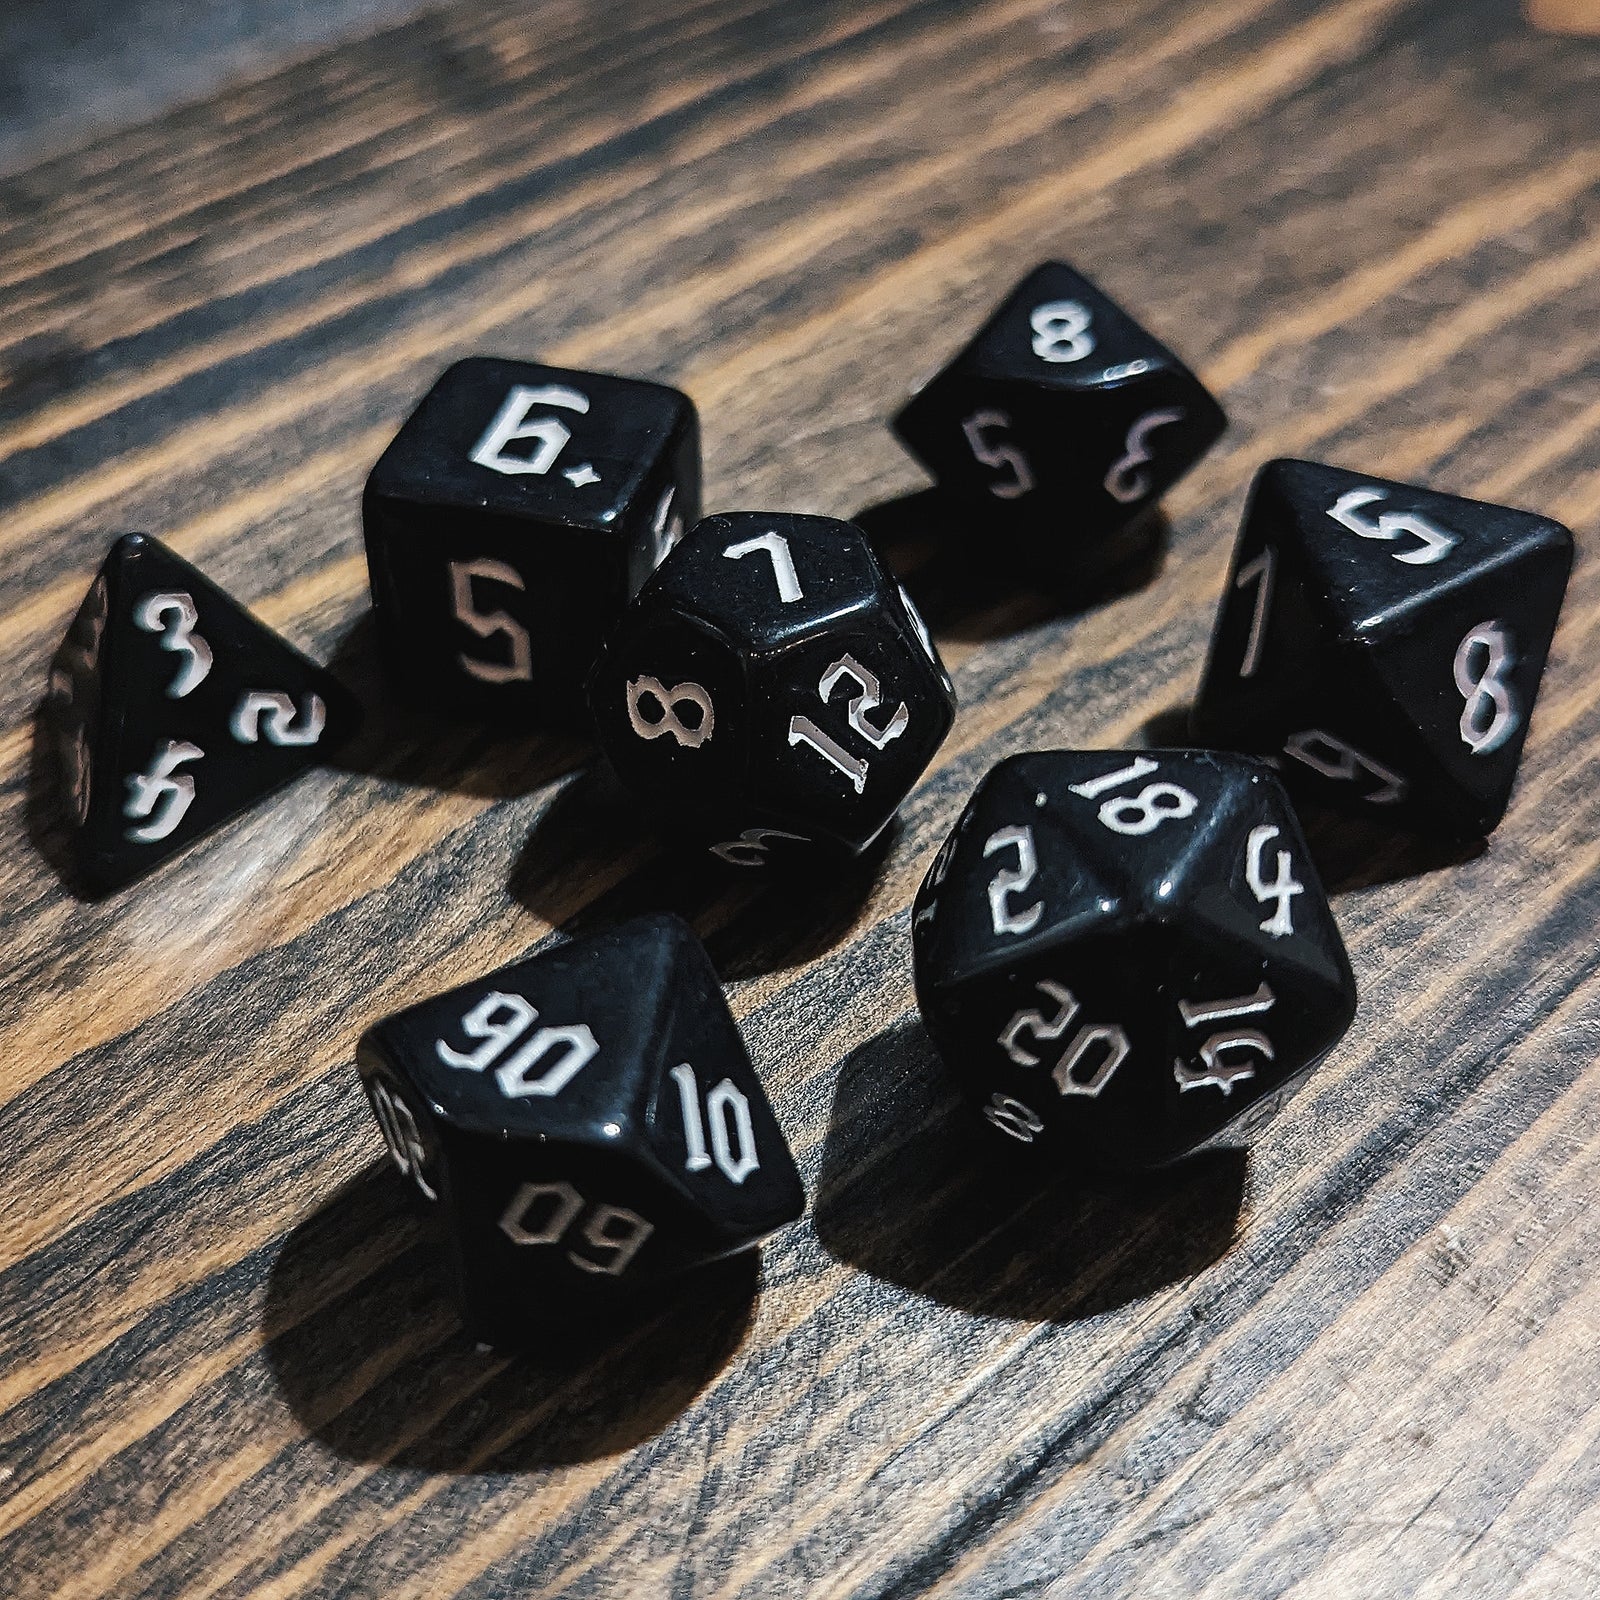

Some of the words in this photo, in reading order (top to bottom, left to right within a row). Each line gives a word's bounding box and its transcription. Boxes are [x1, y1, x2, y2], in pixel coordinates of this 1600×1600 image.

[1030, 300, 1096, 364] 8
[962, 407, 1036, 500] 5
[1326, 488, 1458, 565] 5
[132, 590, 214, 700] 3
[449, 556, 533, 684] 5
[228, 689, 327, 747] 2
[626, 674, 715, 749] 8
[787, 652, 910, 795] 12
[1453, 620, 1522, 755] 8
[1067, 755, 1199, 836] 18
[982, 824, 1045, 936] 2
[1245, 824, 1305, 938] 4
[434, 990, 600, 1098] 90
[997, 978, 1132, 1099] 20
[669, 1062, 761, 1186] 10
